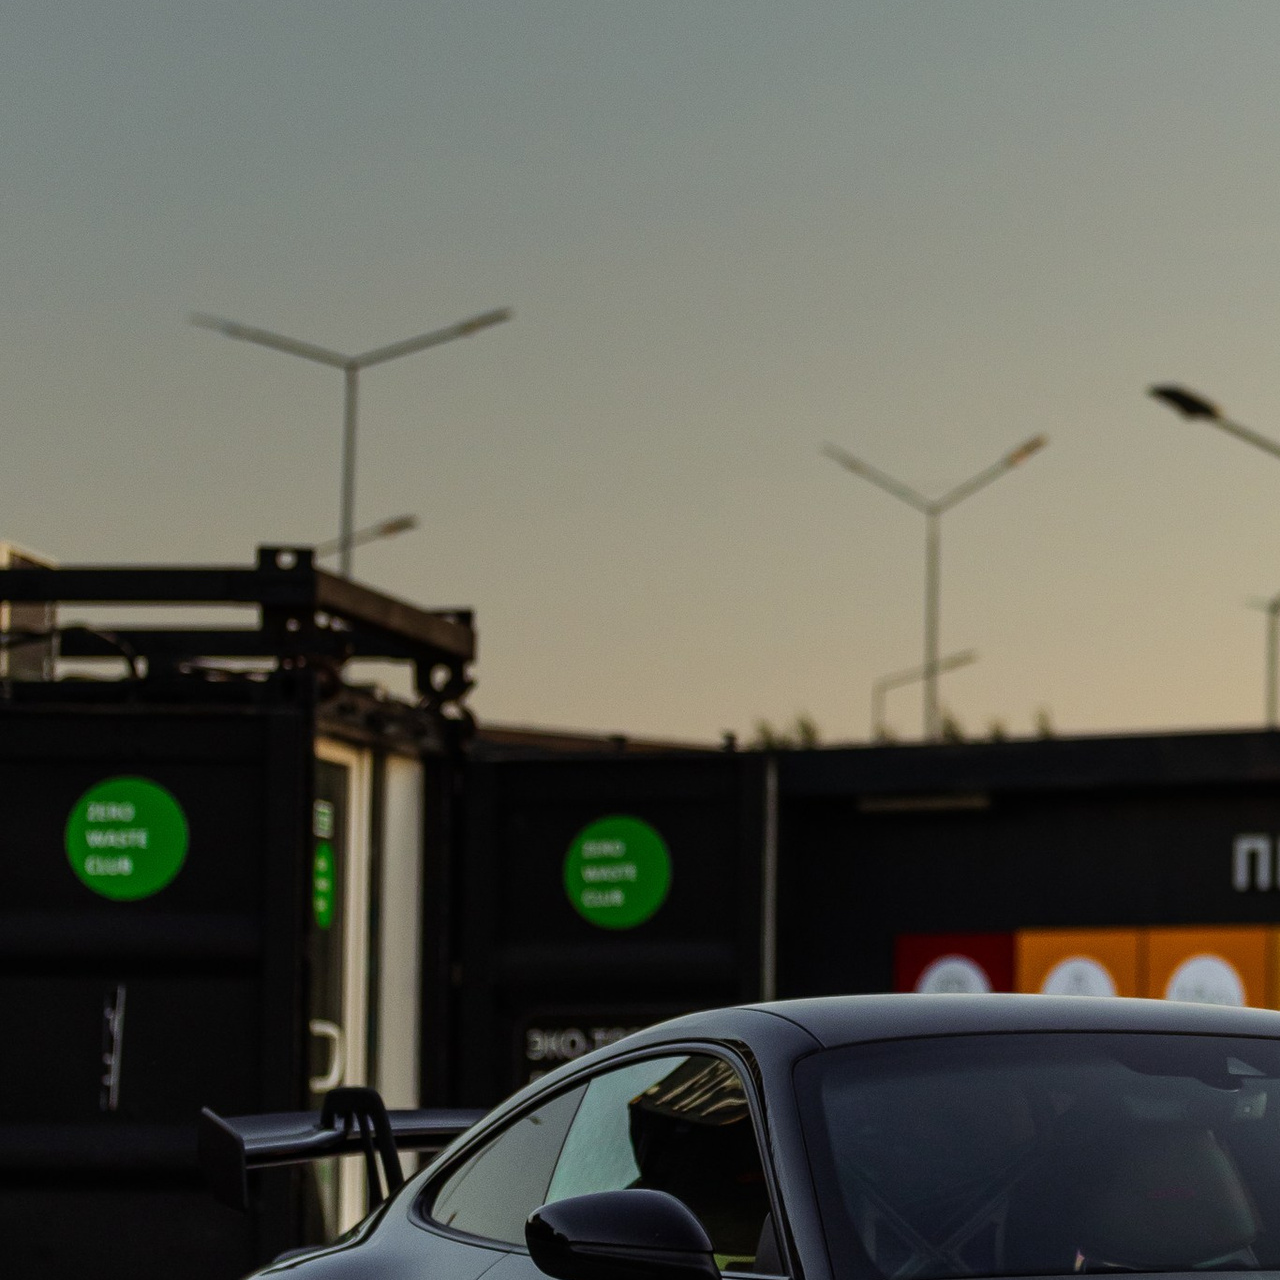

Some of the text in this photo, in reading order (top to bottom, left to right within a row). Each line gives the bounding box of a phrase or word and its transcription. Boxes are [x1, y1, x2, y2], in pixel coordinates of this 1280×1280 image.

[86, 801, 136, 822] ZERO
[85, 828, 149, 849] WASTE
[84, 854, 133, 876] CLUB
